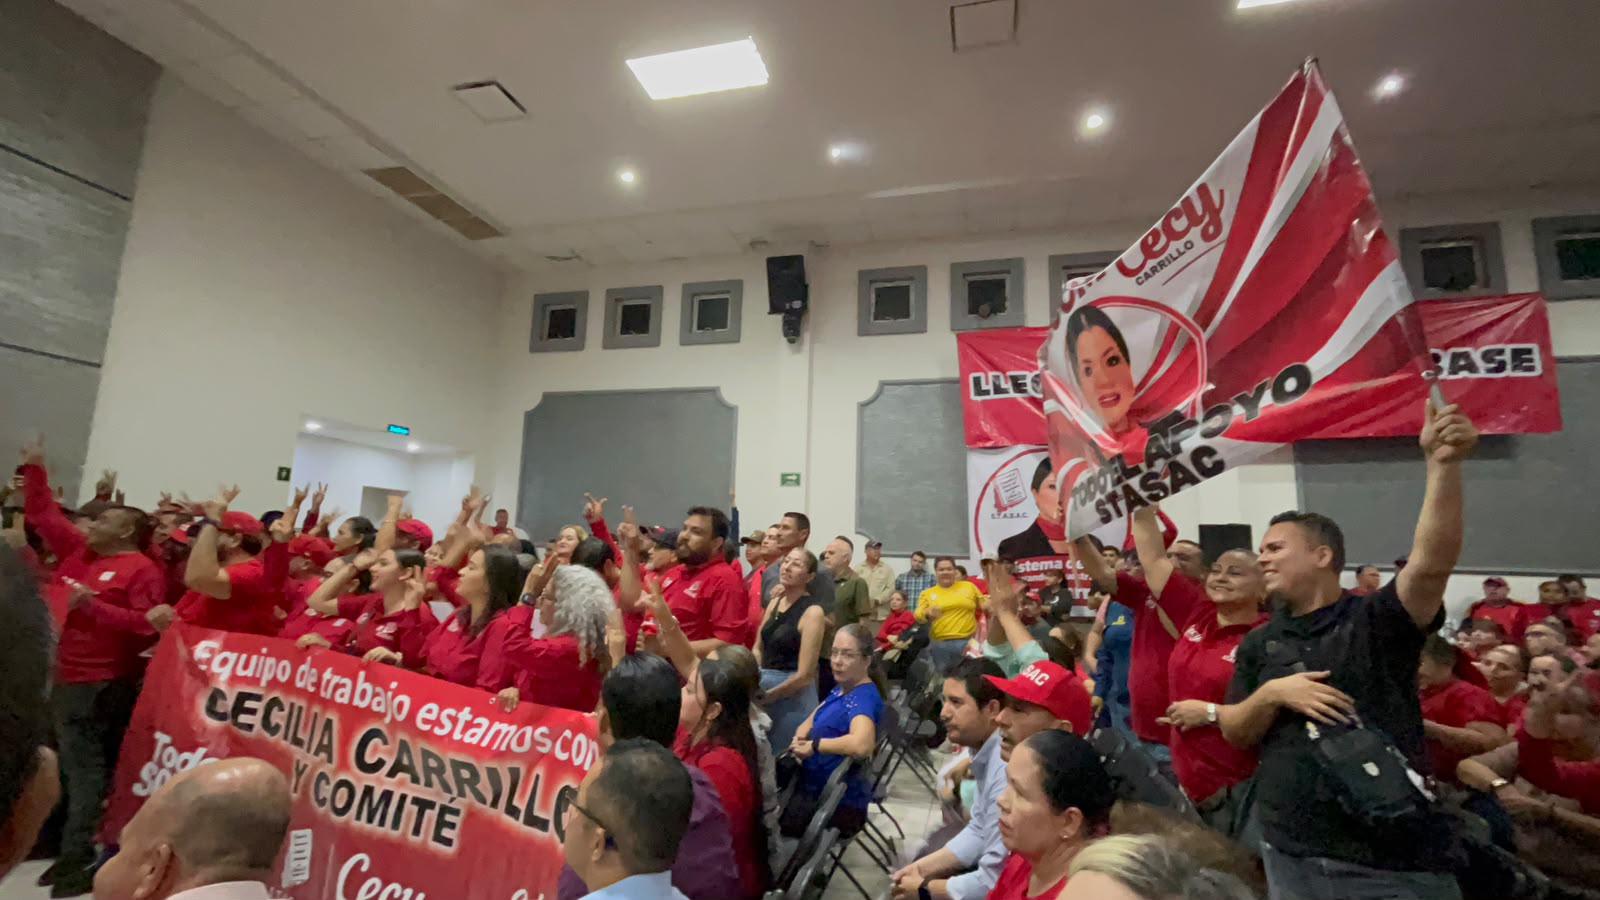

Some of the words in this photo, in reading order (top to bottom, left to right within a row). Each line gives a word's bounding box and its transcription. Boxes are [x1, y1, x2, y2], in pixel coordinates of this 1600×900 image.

[1134, 238, 1195, 287] CARRILLO
[1094, 444, 1225, 525] STASAC
[192, 639, 292, 688] Equipo
[295, 656, 318, 693] de
[319, 666, 411, 724] trabajo
[415, 701, 551, 754] estamos
[204, 687, 335, 765] CECILIA
[292, 760, 310, 795] Y
[313, 771, 462, 848] COMITÉ
